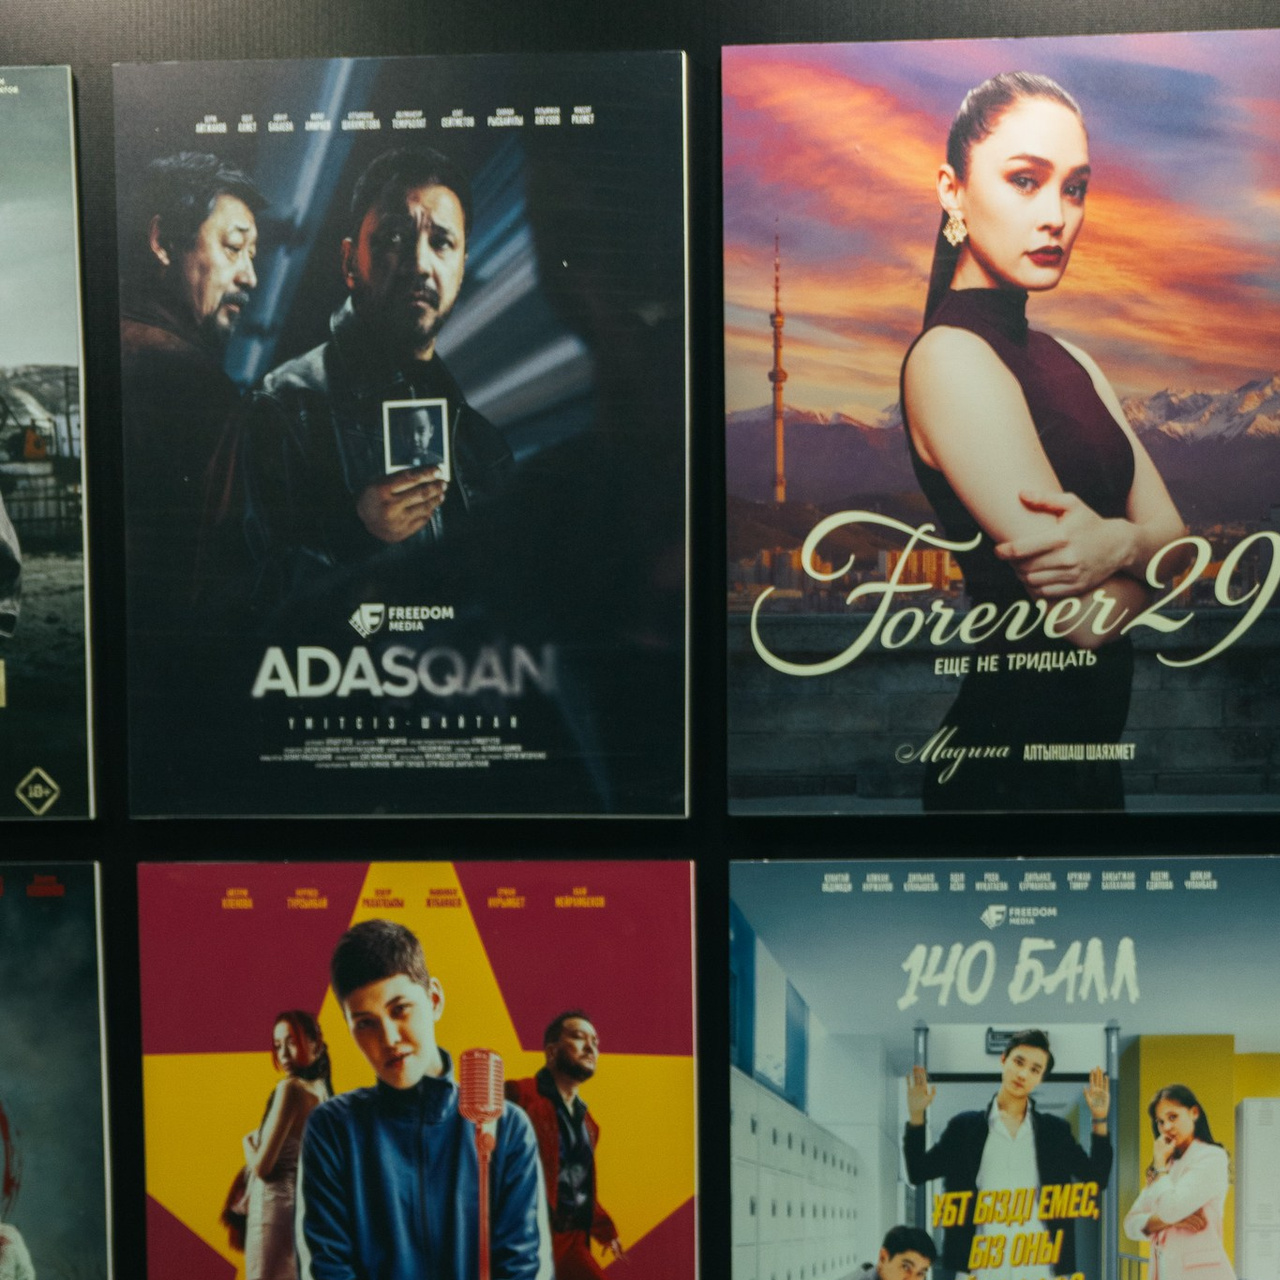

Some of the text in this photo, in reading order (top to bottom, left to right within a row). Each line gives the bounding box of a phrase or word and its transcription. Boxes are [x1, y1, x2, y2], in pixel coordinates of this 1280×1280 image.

[388, 606, 454, 620] FREEDOM
[389, 621, 424, 632] MEDIA
[252, 645, 560, 698] ADASQAN
[934, 649, 1098, 676] ЕЩЕ НЕ ТРИДЦАТЬ
[1008, 906, 1058, 918] FREEDOM
[898, 940, 996, 1011] 140
[1037, 1181, 1099, 1220] ЕМЕС,
[968, 1229, 1064, 1270] БІЗ ОНЫ
